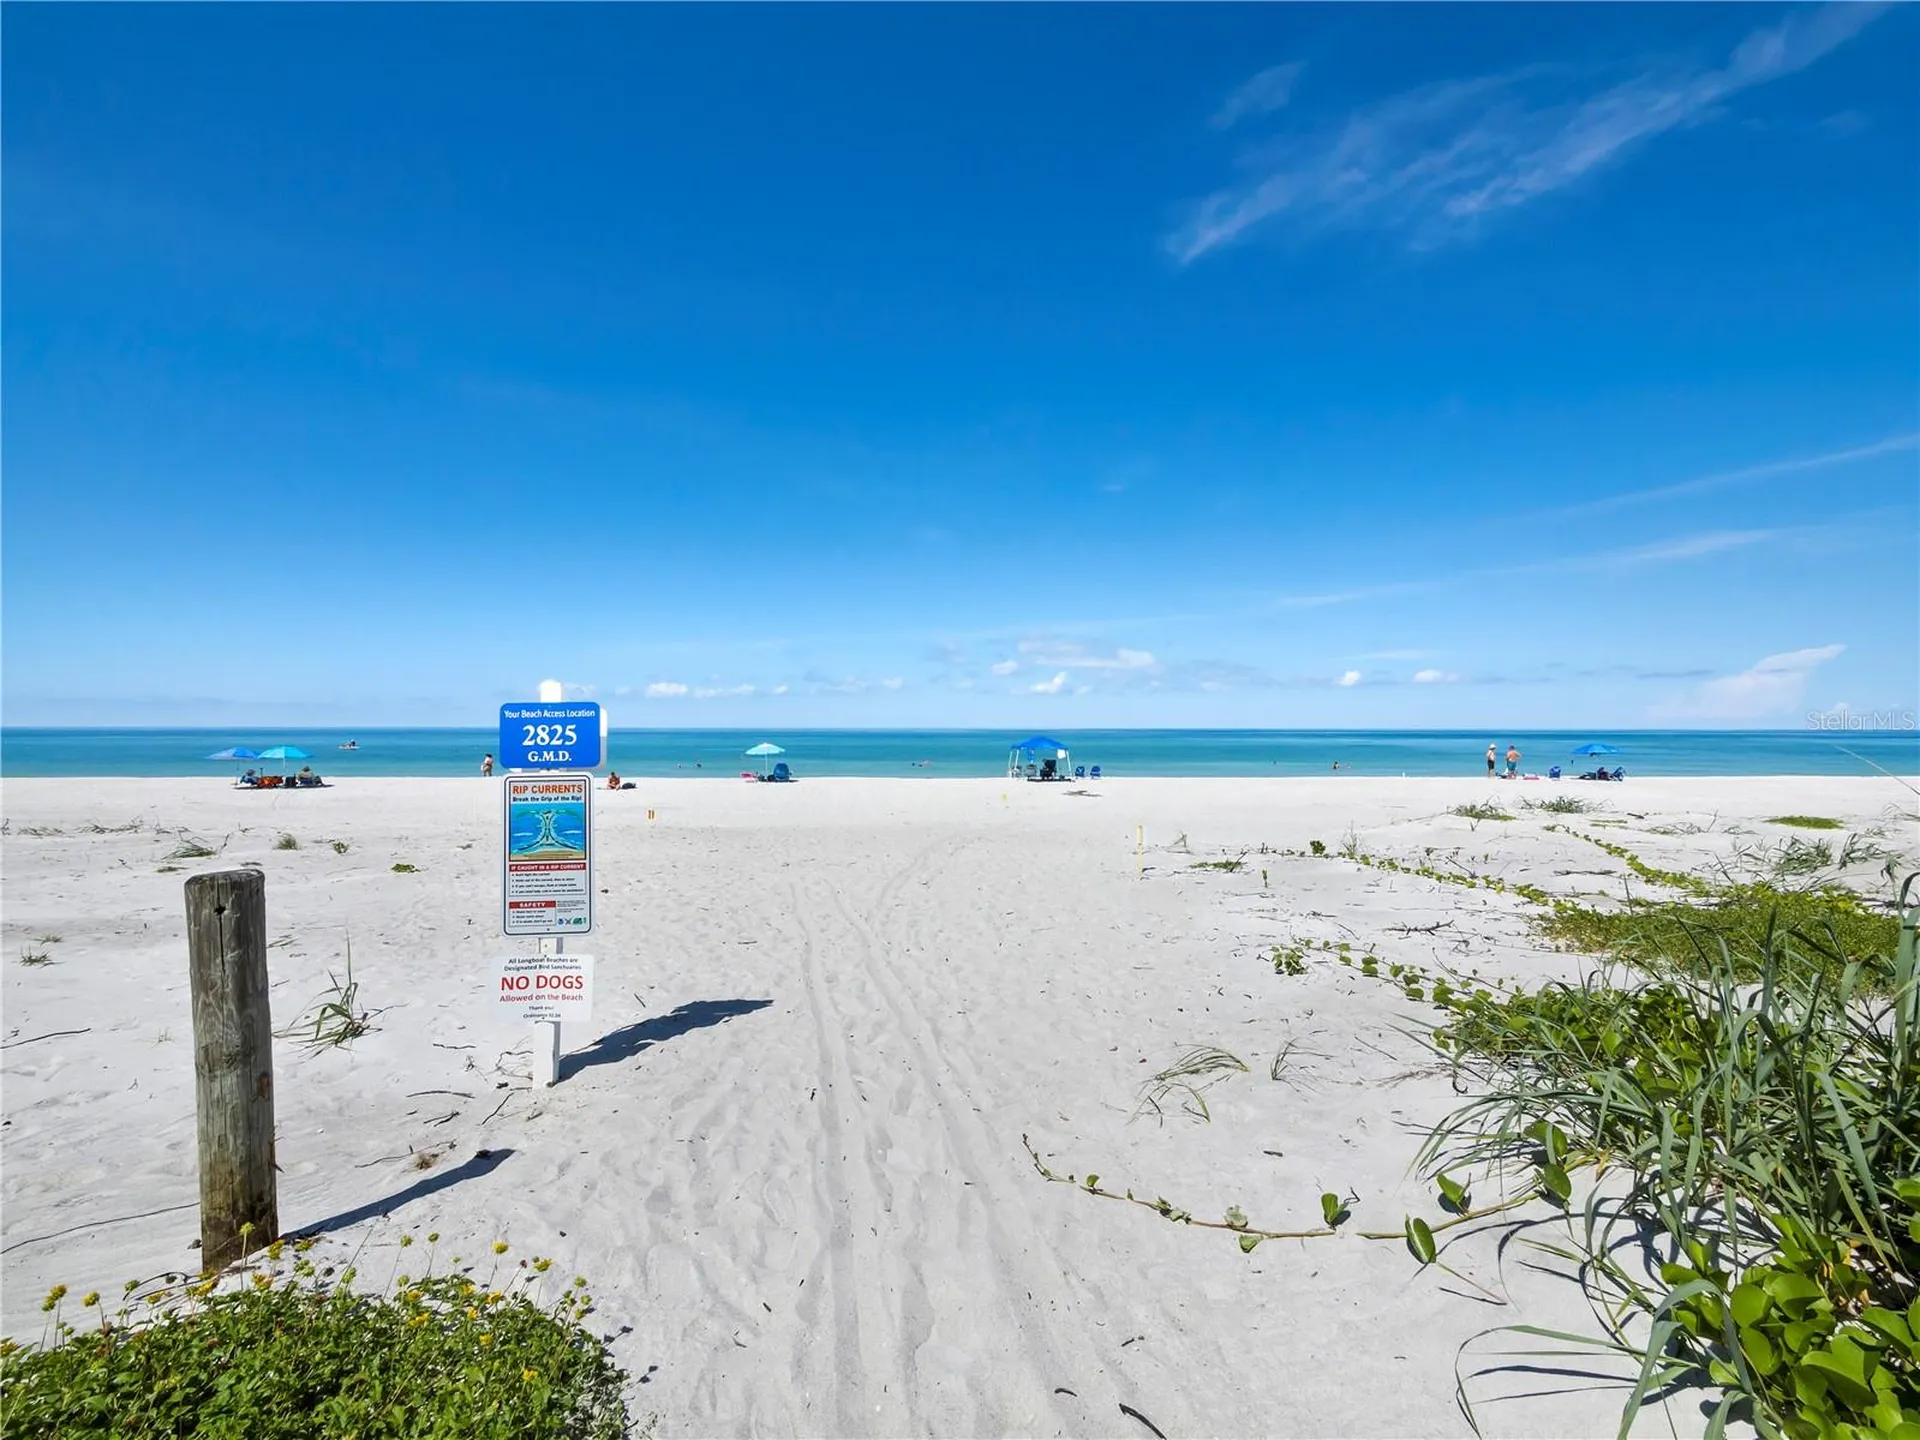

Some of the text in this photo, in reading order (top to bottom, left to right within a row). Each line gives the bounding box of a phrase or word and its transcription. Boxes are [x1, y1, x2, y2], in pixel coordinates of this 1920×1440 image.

[504, 709, 595, 718] Your Beach Access Location
[522, 724, 577, 746] 2825
[528, 750, 572, 762] G.M.D.
[512, 784, 583, 794] RIP CURRENTS
[501, 975, 584, 990] NO DOGS
[500, 993, 534, 1002] Allowed
